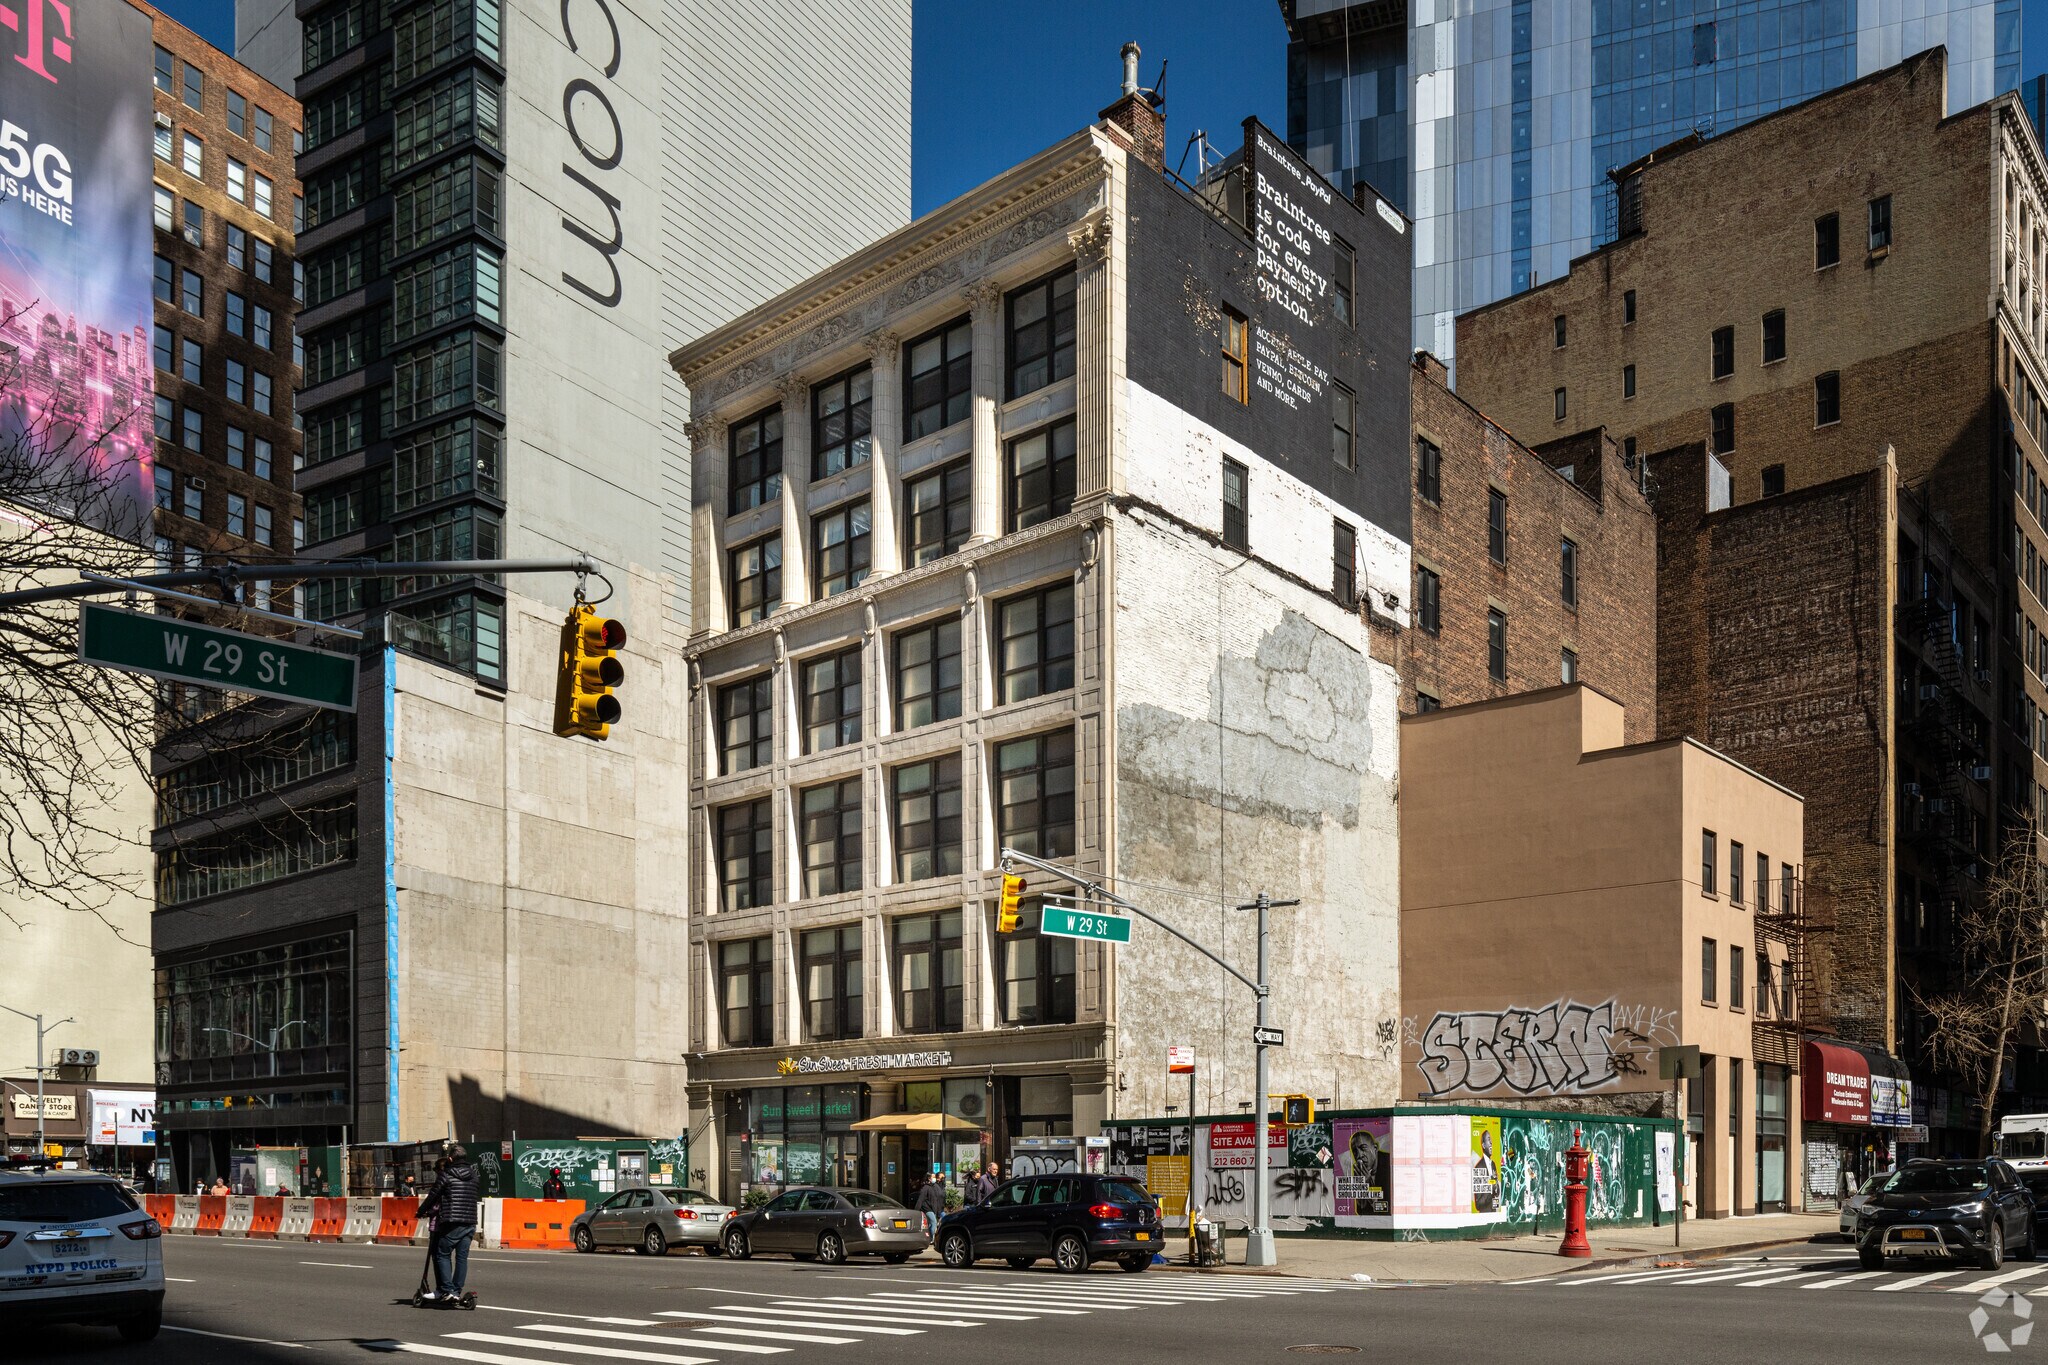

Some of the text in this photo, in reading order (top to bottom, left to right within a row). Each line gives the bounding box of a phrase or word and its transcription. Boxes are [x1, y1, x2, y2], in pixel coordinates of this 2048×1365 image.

[0, 119, 72, 205] 5G
[0, 173, 72, 226] IS HERE
[1256, 172, 1331, 245] Braintree
[1257, 198, 1311, 255] is code
[1257, 224, 1328, 297] for every
[1257, 247, 1313, 303] payment
[1257, 276, 1314, 327] option.
[1256, 341, 1323, 397] PAYPAL, BITCOIN,
[1287, 348, 1312, 372] APPLE
[1256, 358, 1312, 404] VENMO, CARDS
[1256, 375, 1298, 410] AND MORE.
[163, 631, 289, 687] W 29 St
[1067, 915, 1108, 935] W 29 St
[1258, 1032, 1267, 1040] ONE
[799, 1051, 948, 1073] Sun Sweet FRESH MARKET
[1827, 1072, 1846, 1086] DREAM
[1846, 1075, 1868, 1089] TRADER
[762, 1104, 782, 1117] Sun
[785, 1103, 814, 1116] Sweet
[1213, 1135, 1285, 1146] SITE AVAIBLE
[1214, 1157, 1228, 1165] 212
[1230, 1157, 1247, 1165] 660
[55, 1243, 79, 1253] 5272
[25, 1262, 65, 1275] NYPD
[70, 1258, 118, 1272] POLICE
